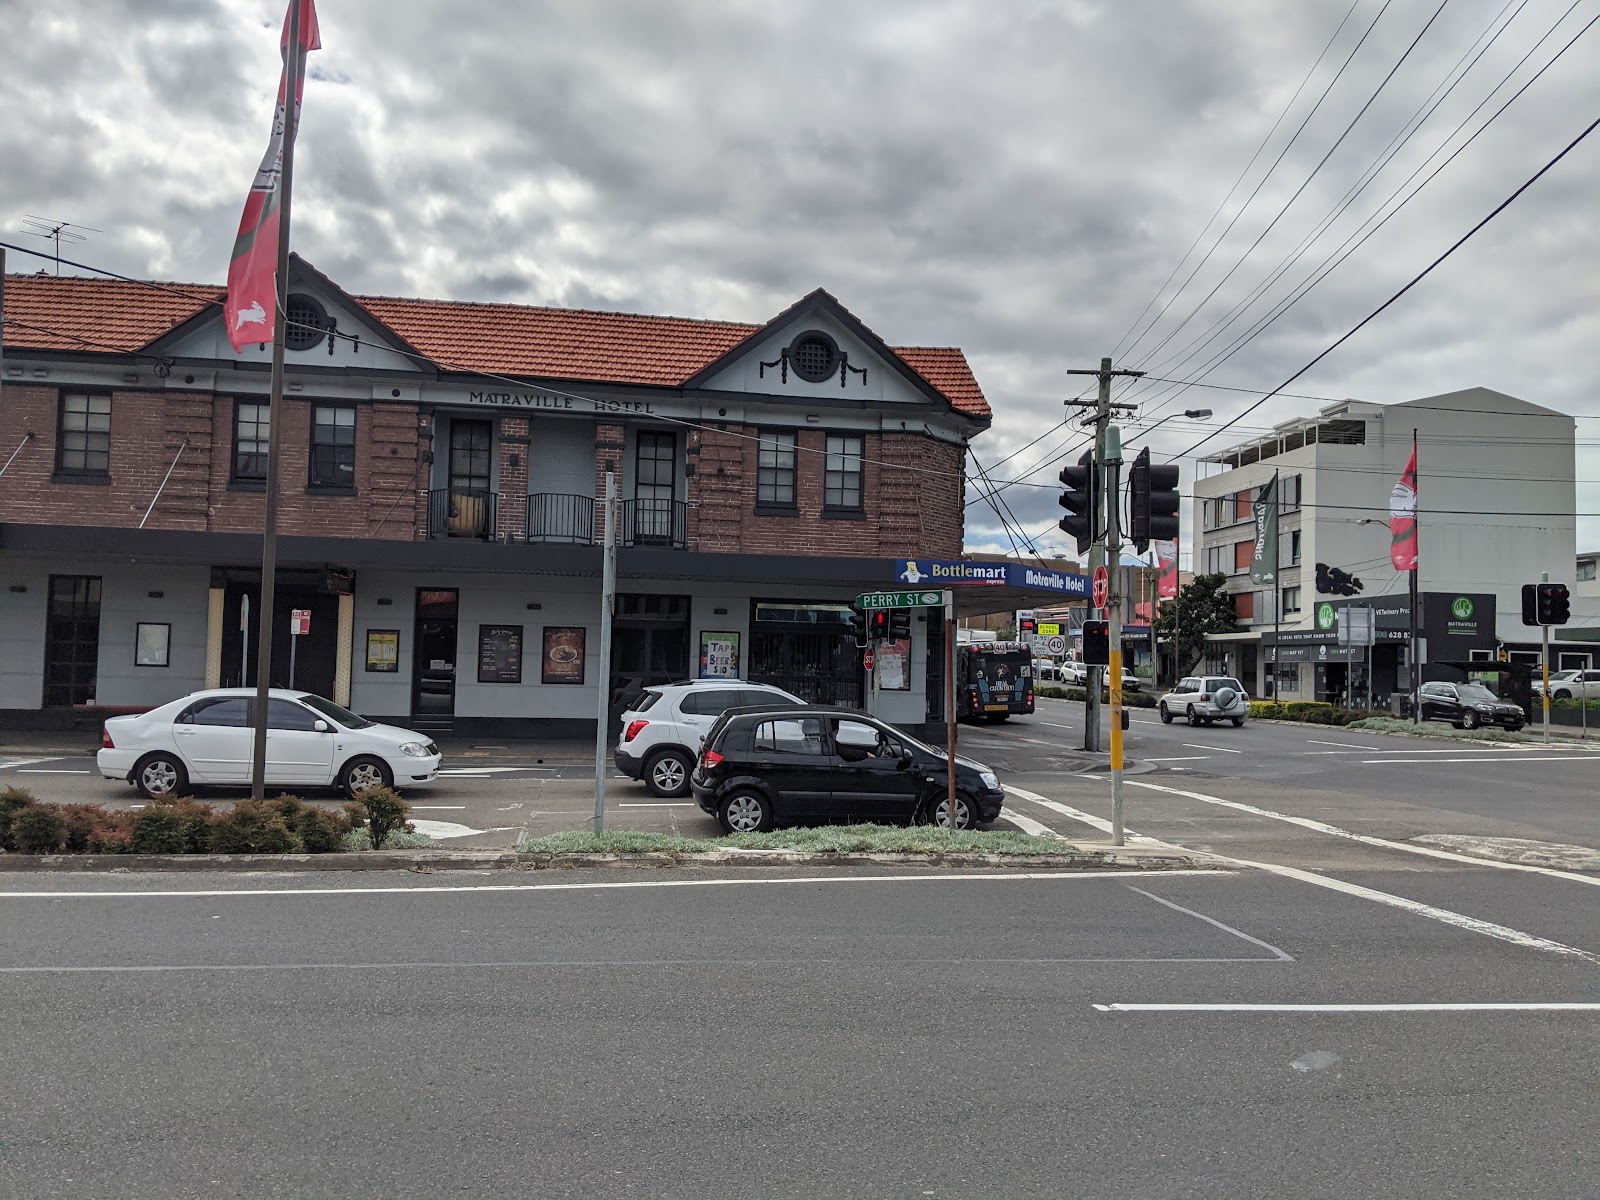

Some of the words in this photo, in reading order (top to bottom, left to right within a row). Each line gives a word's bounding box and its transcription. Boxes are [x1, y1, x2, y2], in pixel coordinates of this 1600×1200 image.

[469, 391, 573, 409] MATRAVILLE
[594, 399, 655, 414] HOTEL
[932, 564, 1006, 579] Bottlemart
[1026, 569, 1064, 589] Matraville
[1065, 577, 1085, 593] Hotel
[1093, 579, 1107, 596] STOP
[863, 593, 900, 607] PERRY
[907, 593, 920, 605] ST
[1389, 631, 1402, 639] 628
[711, 642, 730, 652] TAP
[1050, 640, 1062, 649] 40
[709, 654, 730, 666] BEER
